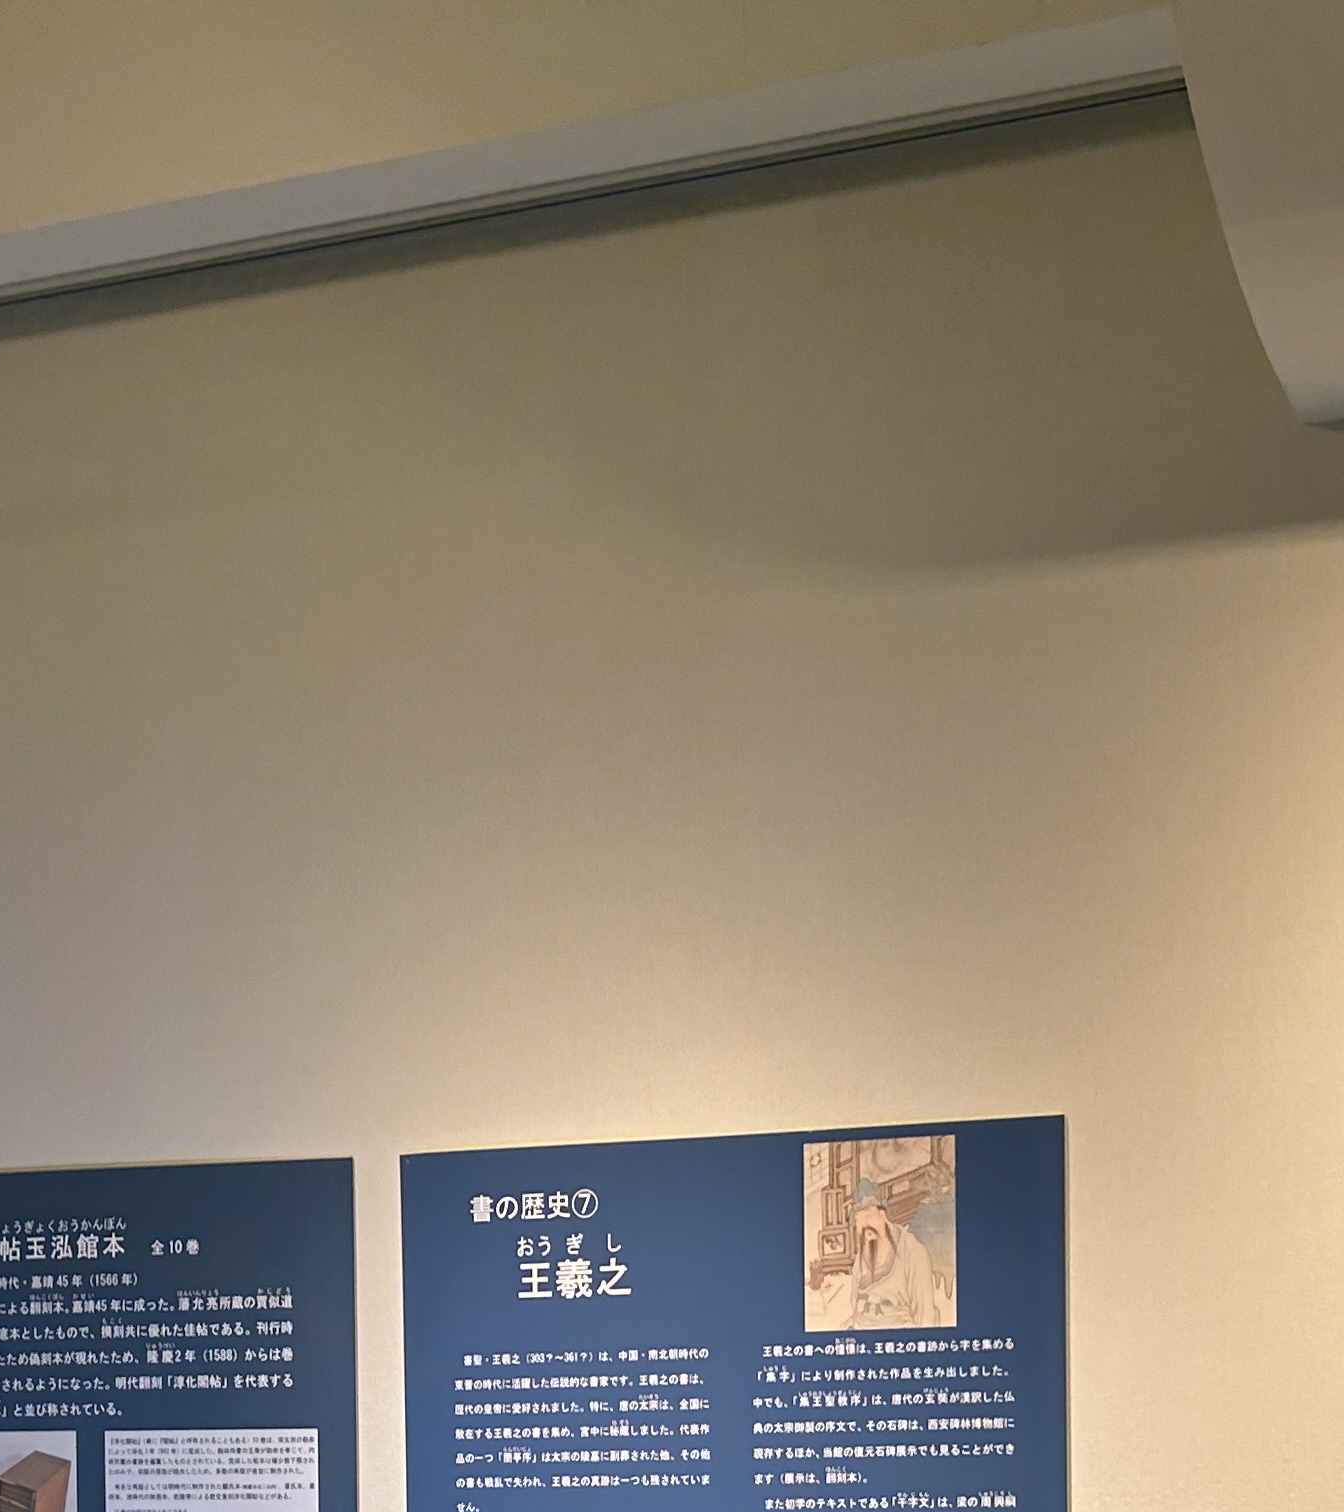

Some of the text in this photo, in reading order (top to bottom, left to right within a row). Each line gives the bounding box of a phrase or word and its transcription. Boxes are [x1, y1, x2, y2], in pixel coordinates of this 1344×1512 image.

[469, 1188, 599, 1223] 書の歴史⑦
[151, 1238, 200, 1256] 全10巻
[517, 1257, 632, 1299] 王羲之
